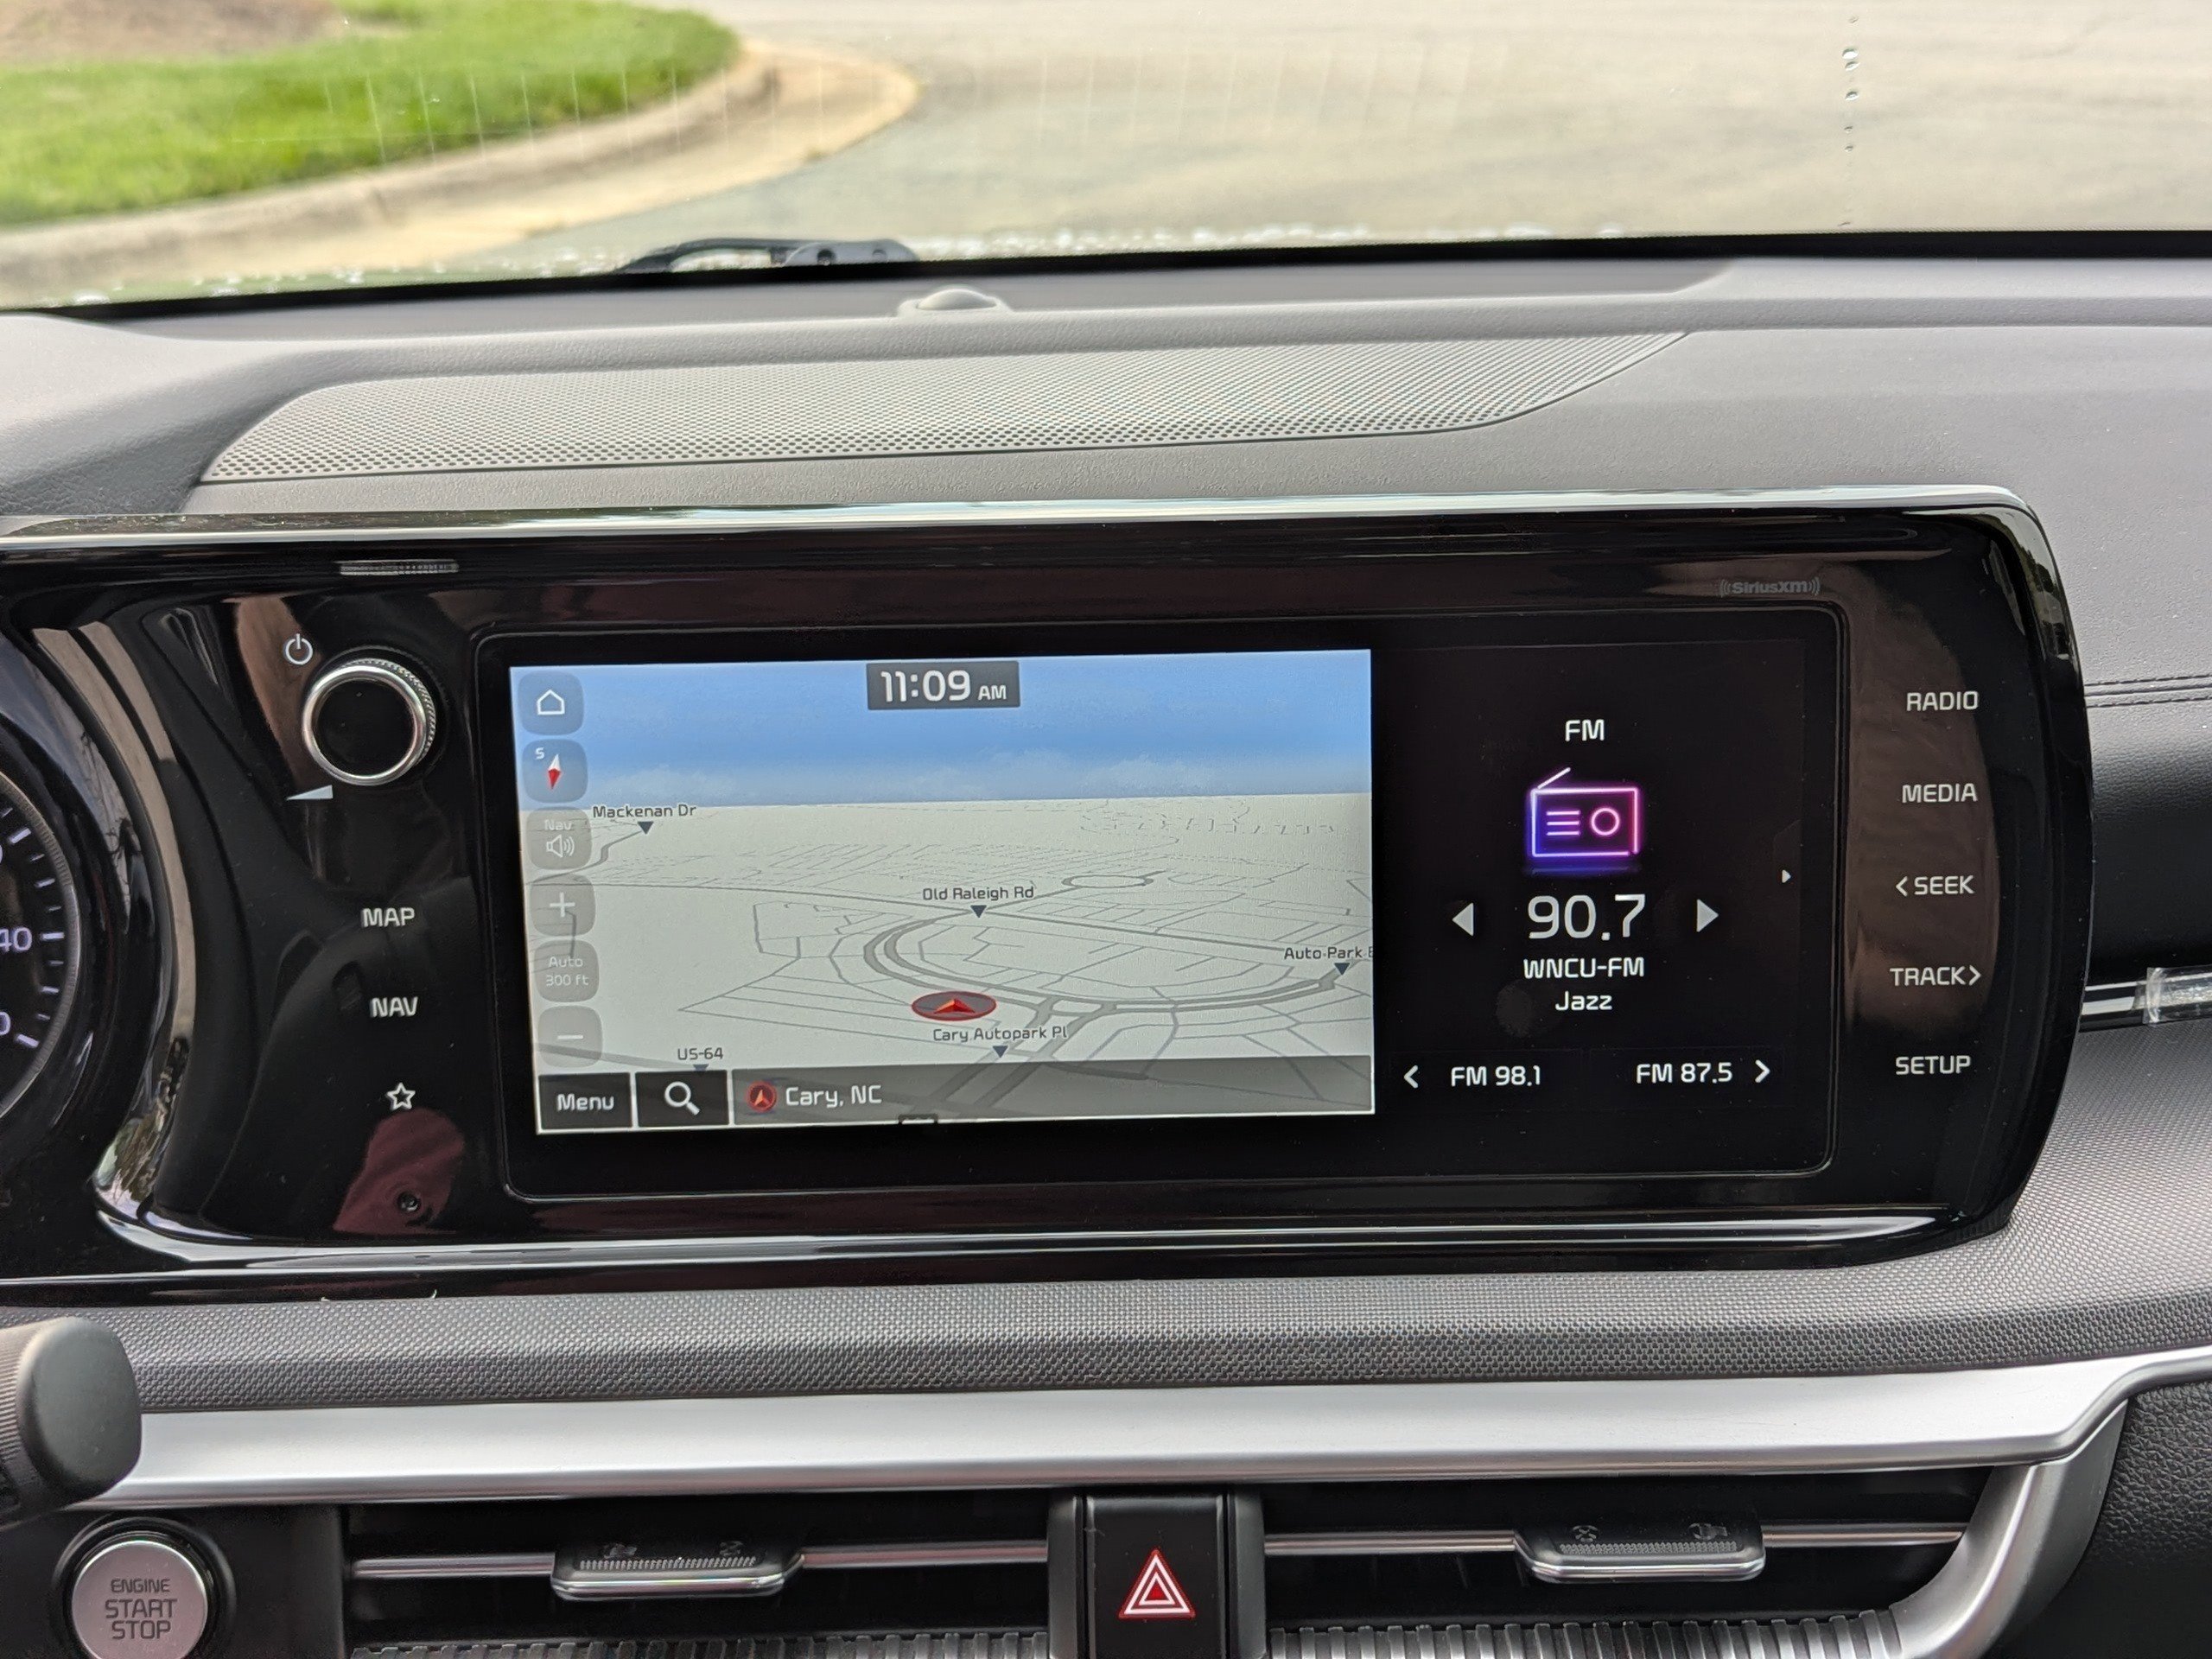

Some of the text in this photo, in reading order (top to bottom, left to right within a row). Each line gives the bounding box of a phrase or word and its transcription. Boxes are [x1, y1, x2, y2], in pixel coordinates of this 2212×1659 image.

[880, 670, 1007, 702] 11:09 AM
[1905, 691, 1980, 711] RADIO
[1565, 719, 1605, 741] FM
[535, 747, 544, 760] S
[1901, 783, 1979, 804] MEDIA
[592, 803, 696, 819] Mackenan Dr
[544, 817, 572, 832] Nav
[922, 885, 1034, 904] Old Raleigh Rd
[1913, 874, 1974, 895] SEEK
[360, 907, 416, 929] MAP
[1527, 893, 1646, 942] 90.7
[548, 954, 583, 969] Auto
[1283, 947, 1322, 960] Auto
[1327, 946, 1363, 959] Park
[1523, 957, 1645, 979] WNCU-FM
[1889, 966, 1967, 987] TRACK
[545, 973, 588, 987] 300 ft
[370, 996, 418, 1019] NAV
[1555, 991, 1613, 1012] Jazz
[932, 1026, 1068, 1043] Cary Autopark Pl
[677, 1046, 723, 1061] US-64
[1636, 1062, 1732, 1084] FM 87.5
[1895, 1055, 1971, 1076] SETUP
[1451, 1065, 1541, 1087] FM 98.1
[557, 1093, 615, 1112] Menu
[785, 1084, 882, 1109] Cary, NC
[111, 1578, 171, 1593] ENGINE
[105, 1599, 178, 1619] START
[111, 1620, 172, 1640] STOP
